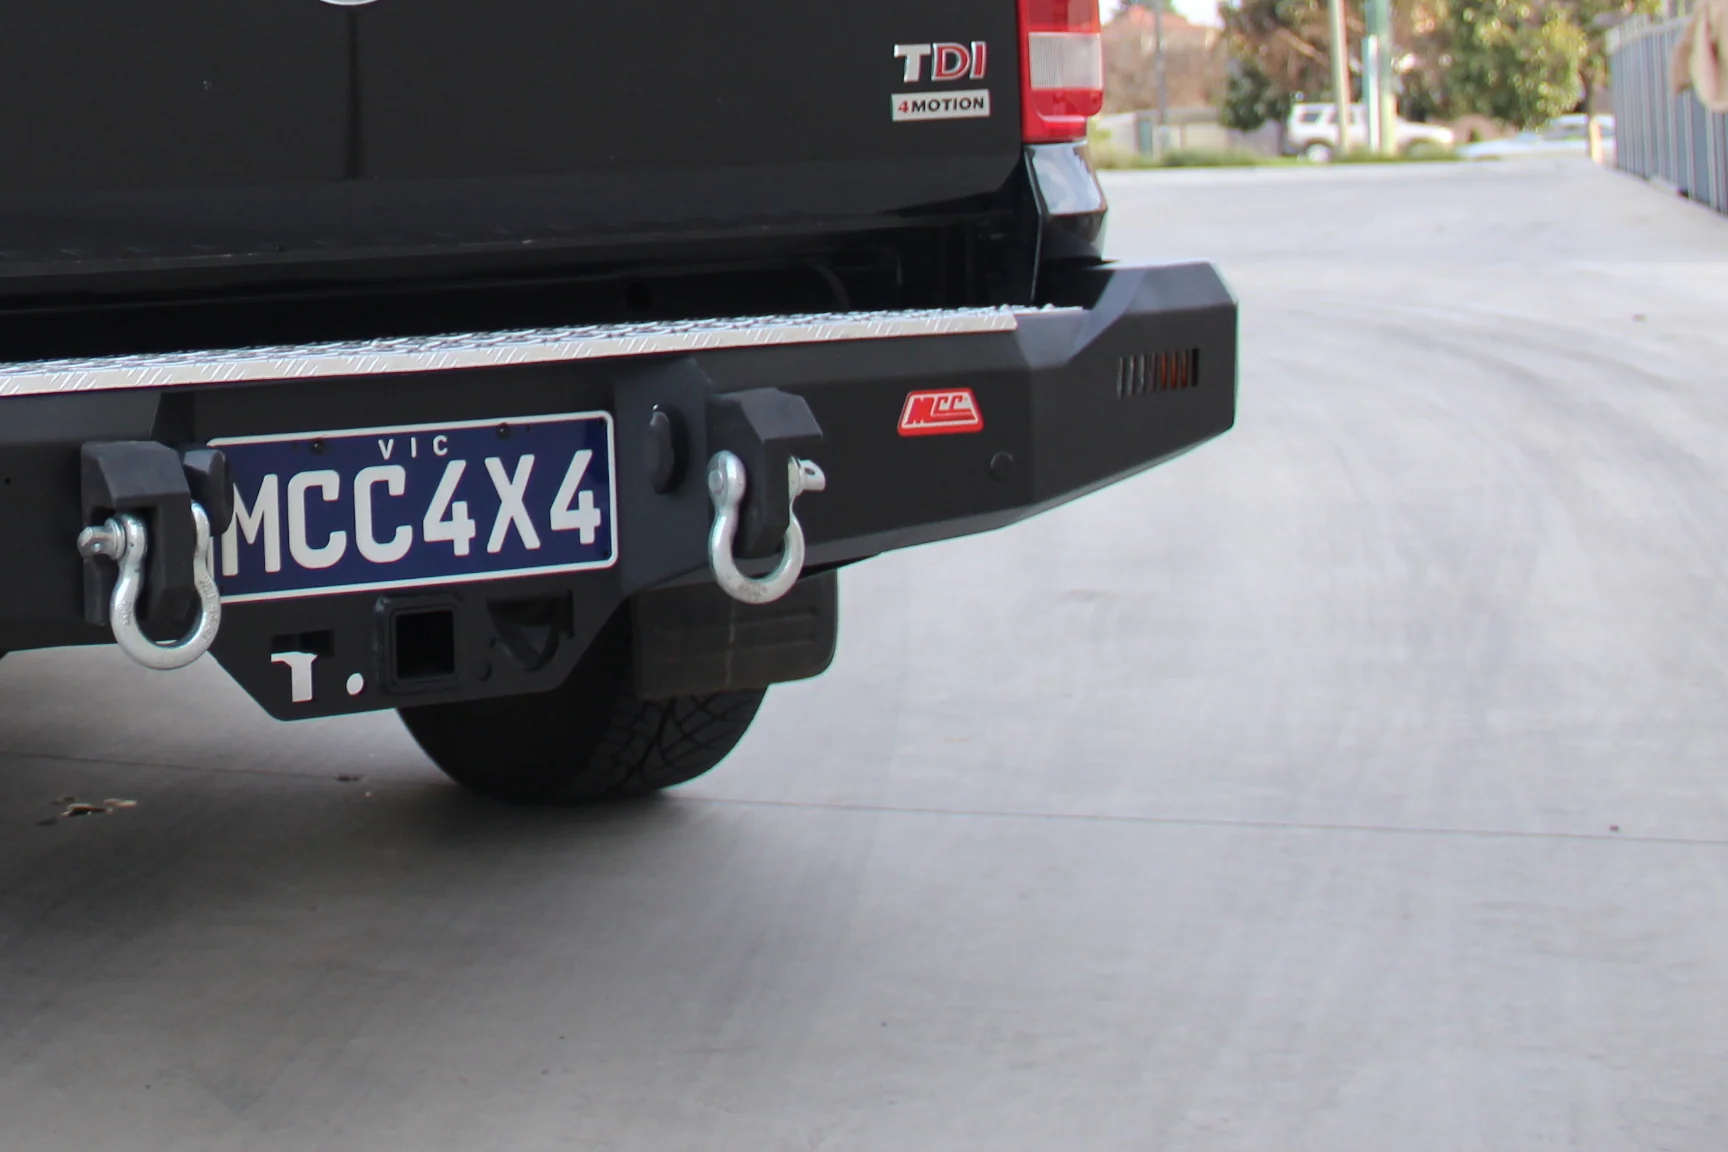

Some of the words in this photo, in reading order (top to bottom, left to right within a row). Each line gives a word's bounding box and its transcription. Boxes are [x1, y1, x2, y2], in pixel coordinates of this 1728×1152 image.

[893, 40, 987, 83] TDI
[897, 94, 985, 115] 4MOTION
[902, 395, 978, 427] MCC
[378, 434, 449, 460] VIC
[221, 449, 602, 577] MCC4X4
